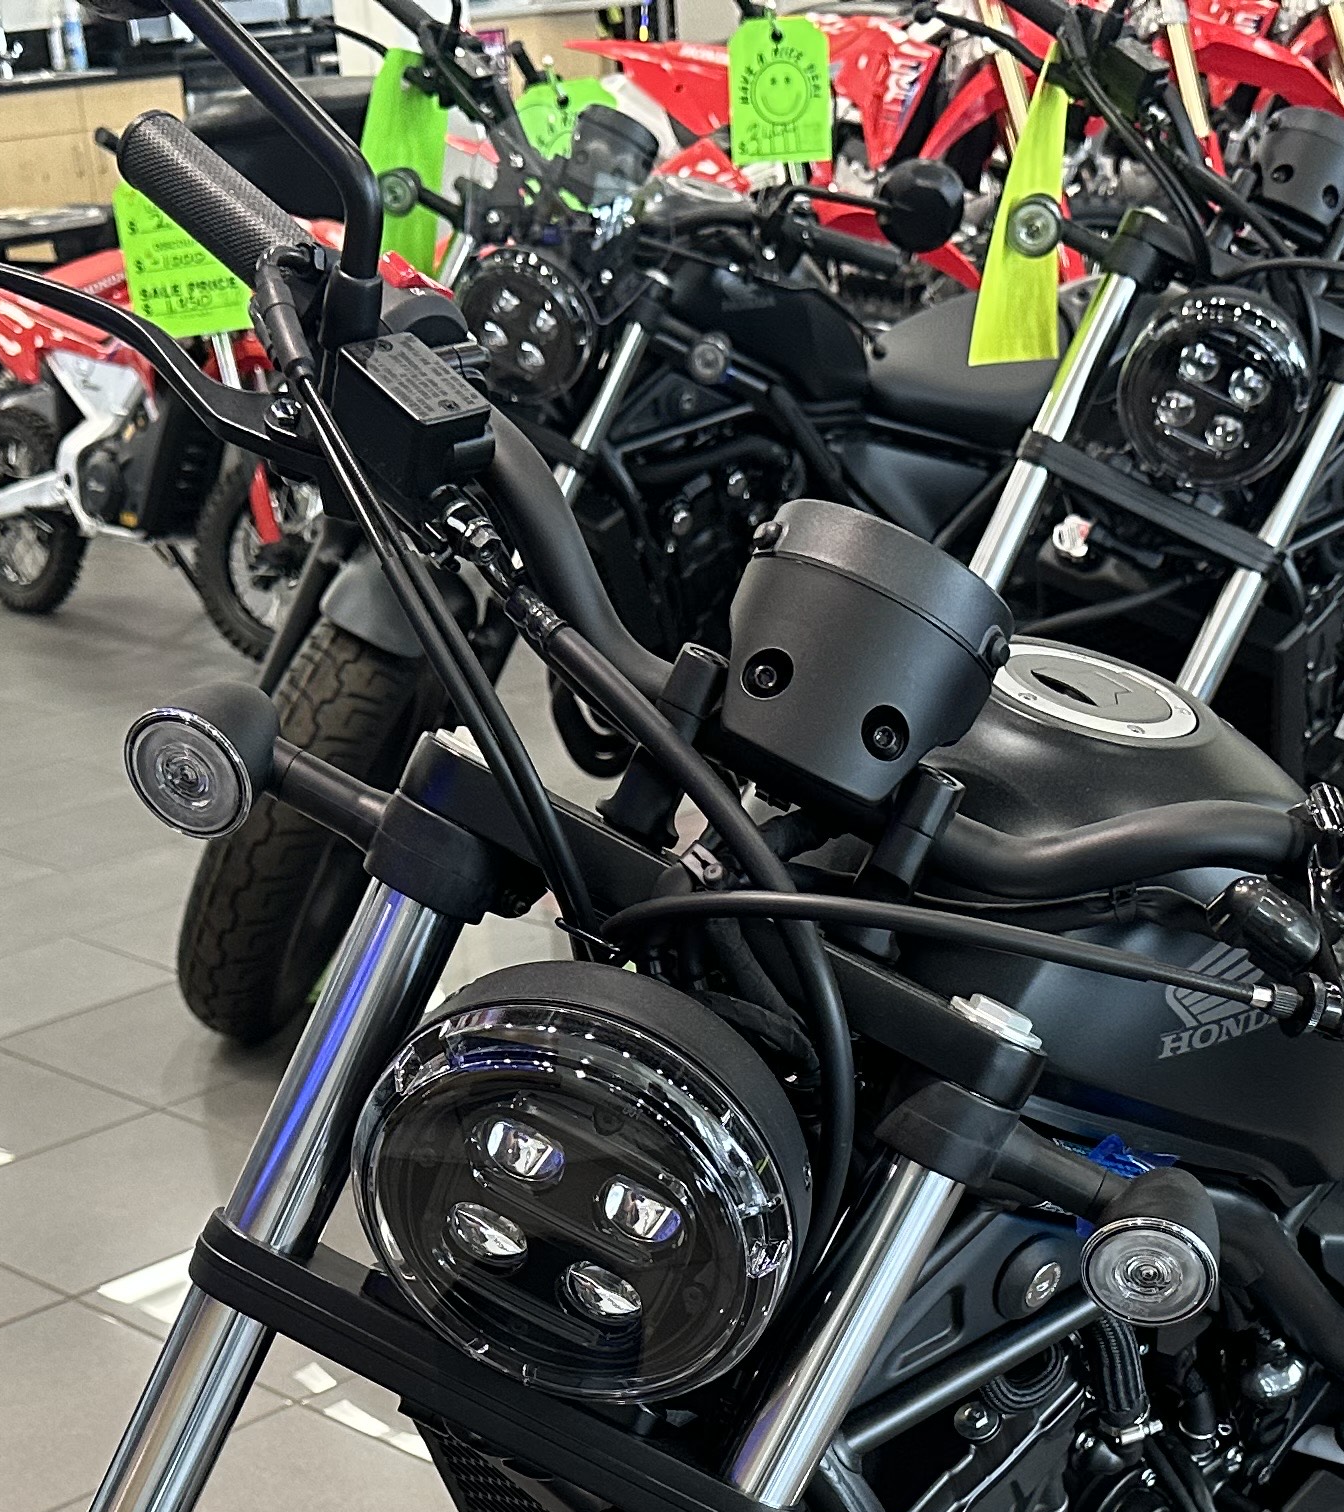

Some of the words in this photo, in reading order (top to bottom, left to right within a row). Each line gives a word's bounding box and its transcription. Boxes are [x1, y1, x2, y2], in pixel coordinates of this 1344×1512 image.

[139, 283, 181, 301] SALE
[187, 276, 240, 295] PRICE
[1158, 1010, 1278, 1060] HOND
